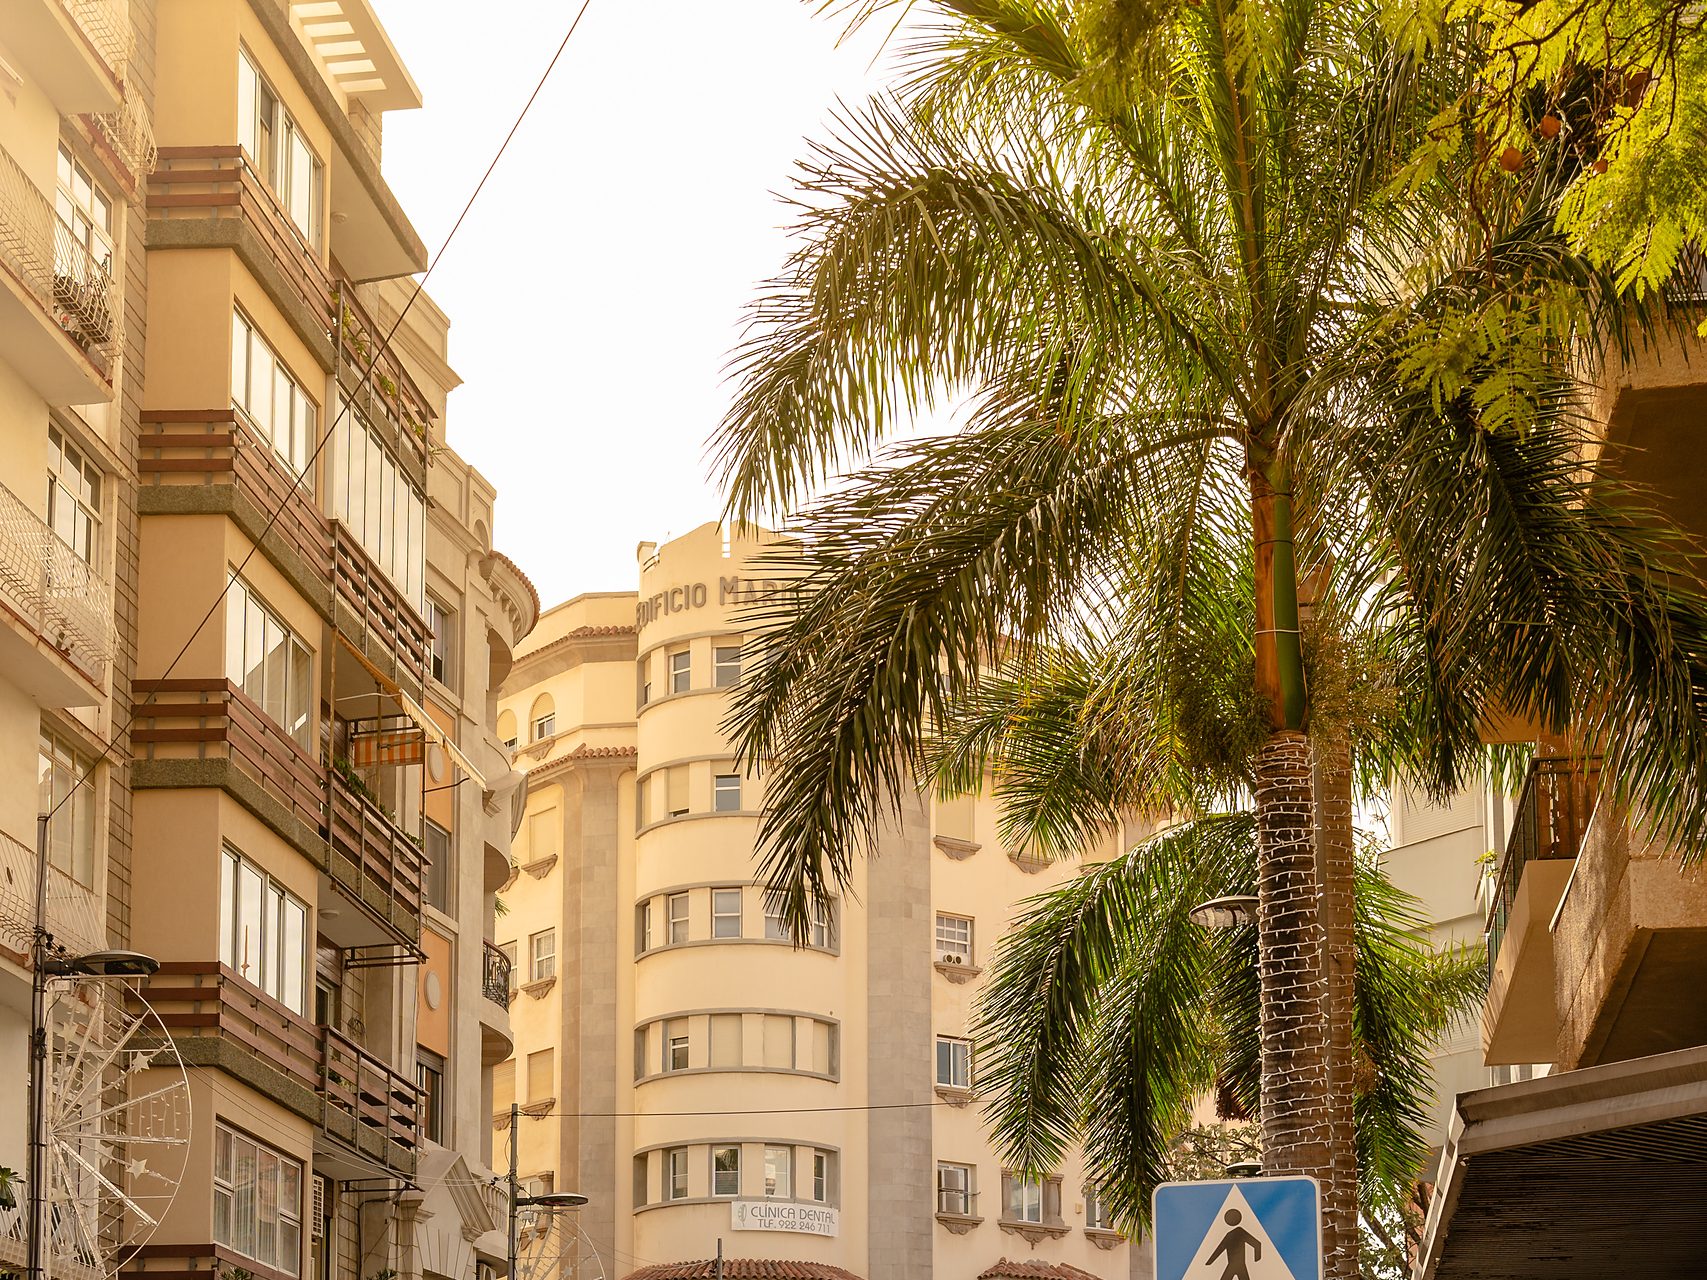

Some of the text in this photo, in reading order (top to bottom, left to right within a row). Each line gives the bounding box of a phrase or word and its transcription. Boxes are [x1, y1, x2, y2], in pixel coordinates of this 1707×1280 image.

[750, 1203, 836, 1225] CLÍNICA DENTAL
[757, 1218, 831, 1234] TLF. 922 246 711
